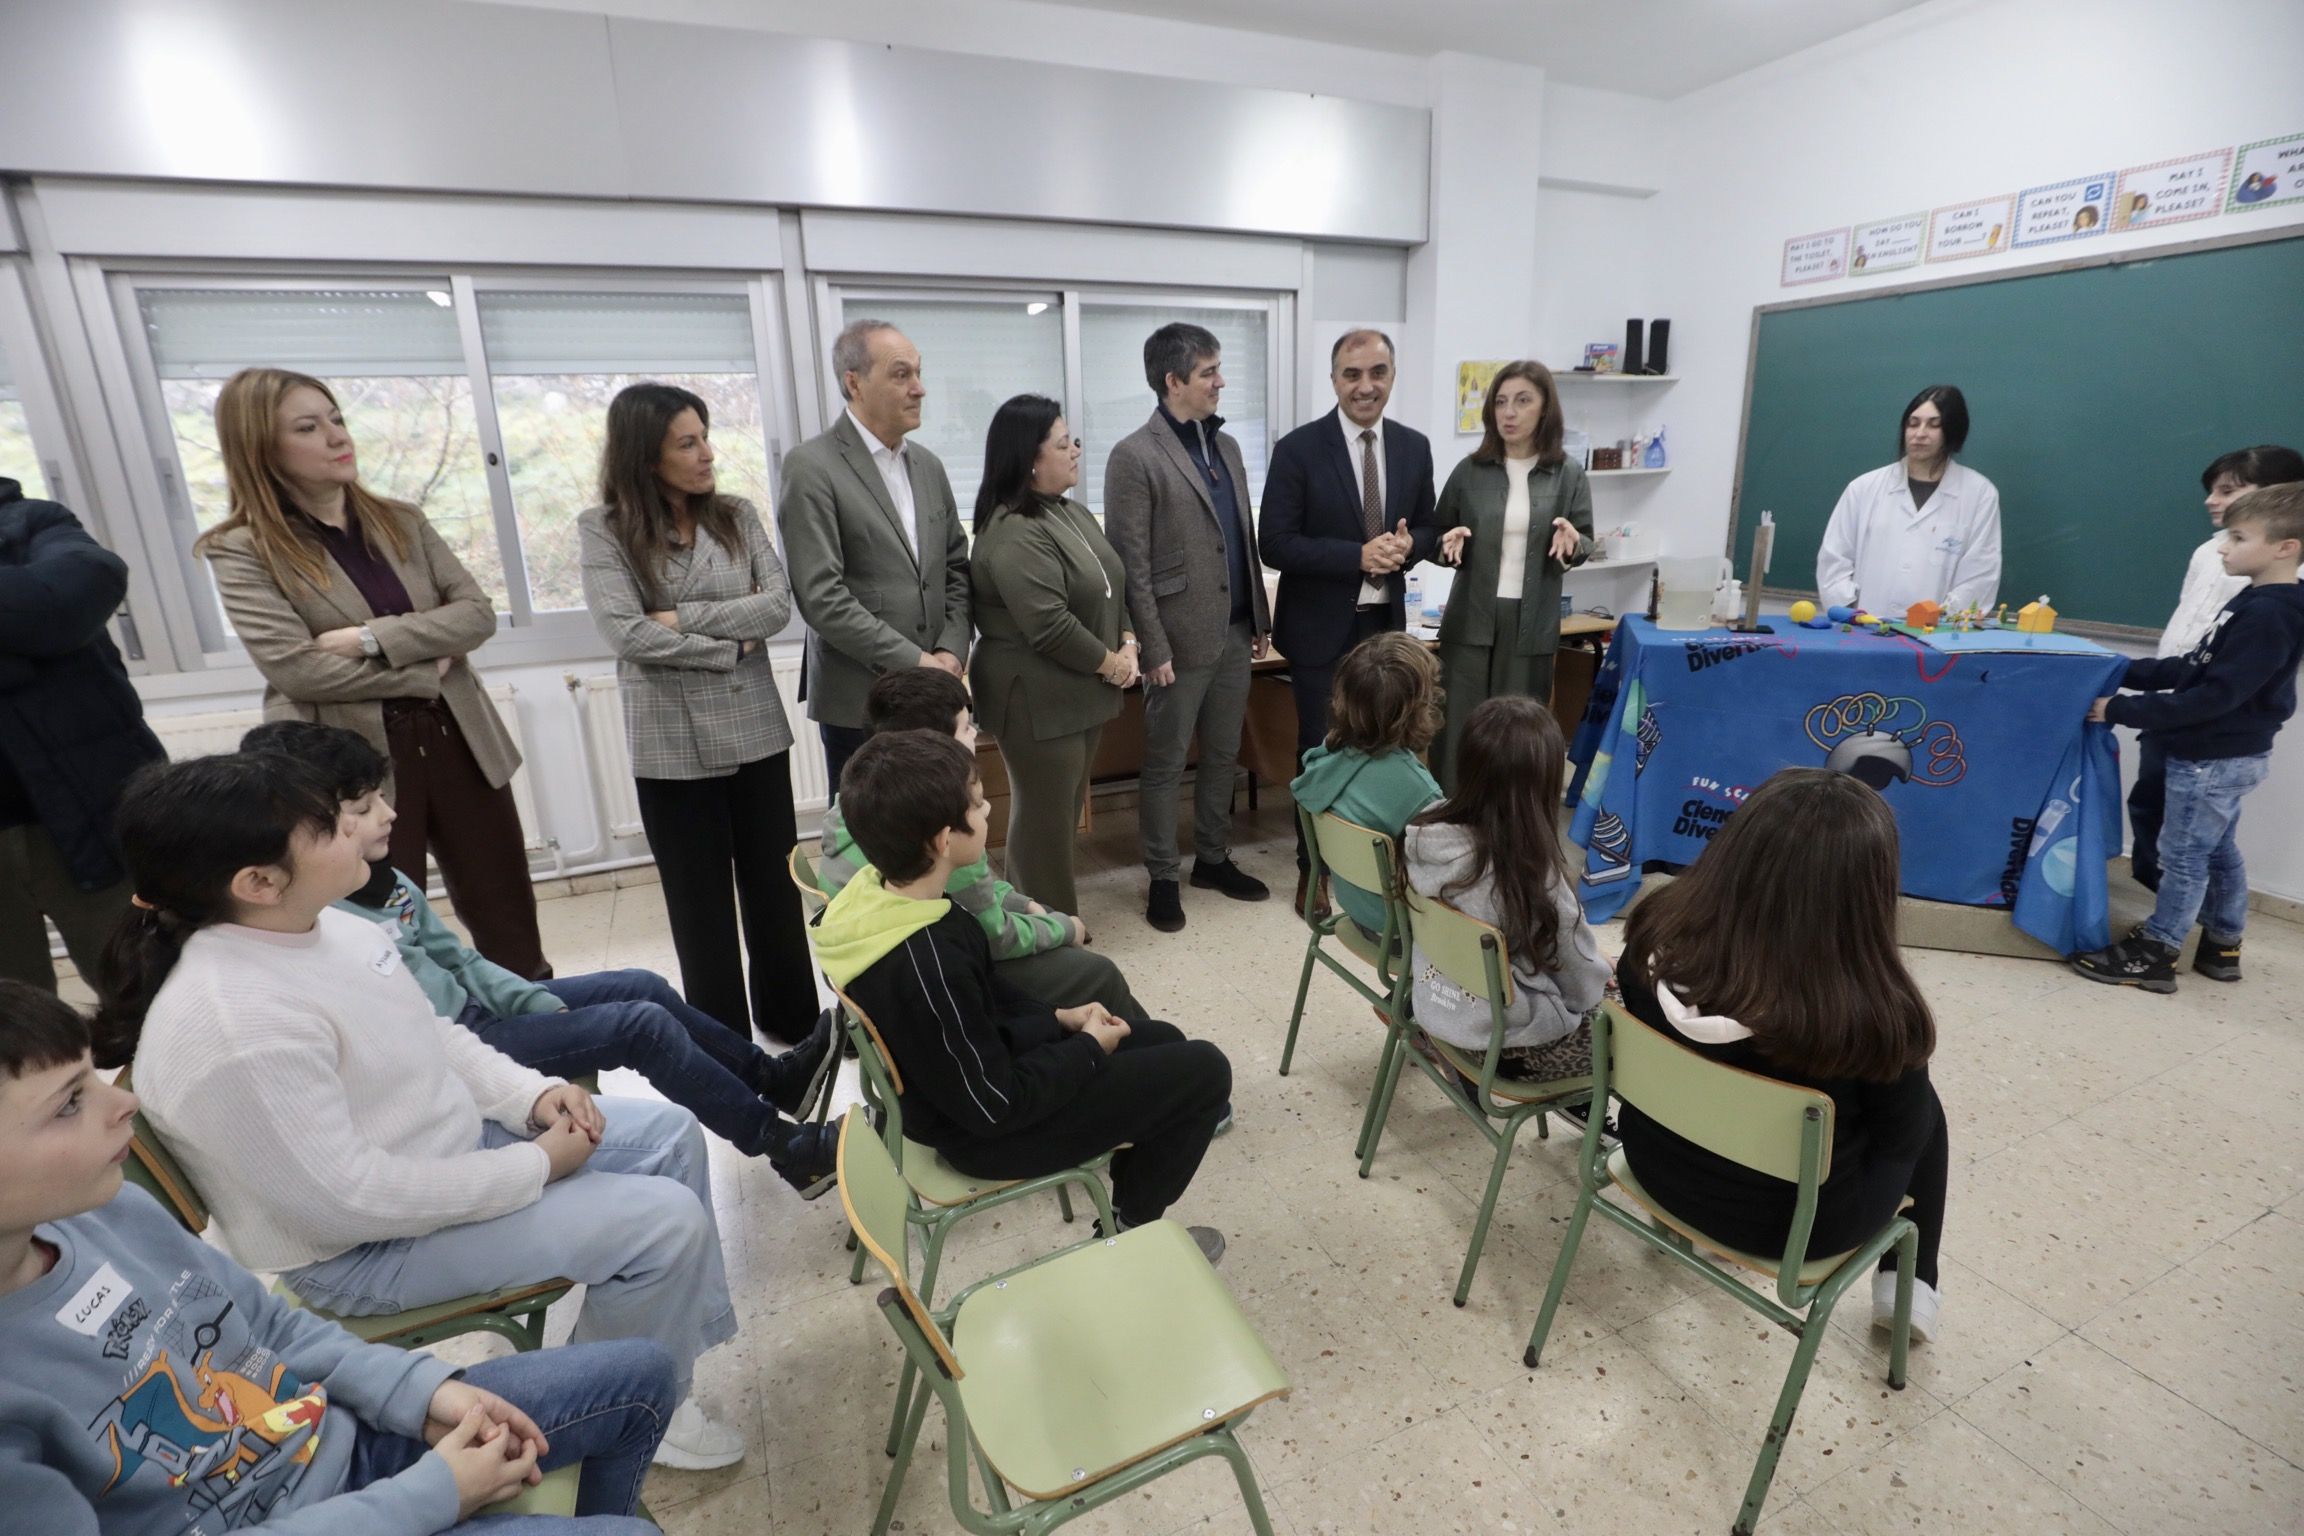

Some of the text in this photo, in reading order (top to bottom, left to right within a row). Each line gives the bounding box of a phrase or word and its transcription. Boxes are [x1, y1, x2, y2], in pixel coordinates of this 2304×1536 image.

[2278, 146, 2304, 160] WHA
[2168, 169, 2195, 182] MAY
[2288, 162, 2304, 174] AR
[2294, 178, 2304, 189] O
[2031, 191, 2077, 208] CAN YOU
[2155, 184, 2190, 200] COME
[2154, 197, 2206, 214] PLEASE?
[1944, 222, 1984, 235] BORROW
[2028, 219, 2069, 233] PLEASE?
[1692, 776, 1750, 801] FUN SCI
[1672, 816, 1720, 841] Dive
[76, 1286, 111, 1324] LUCAS
[153, 1307, 174, 1334] FOR
